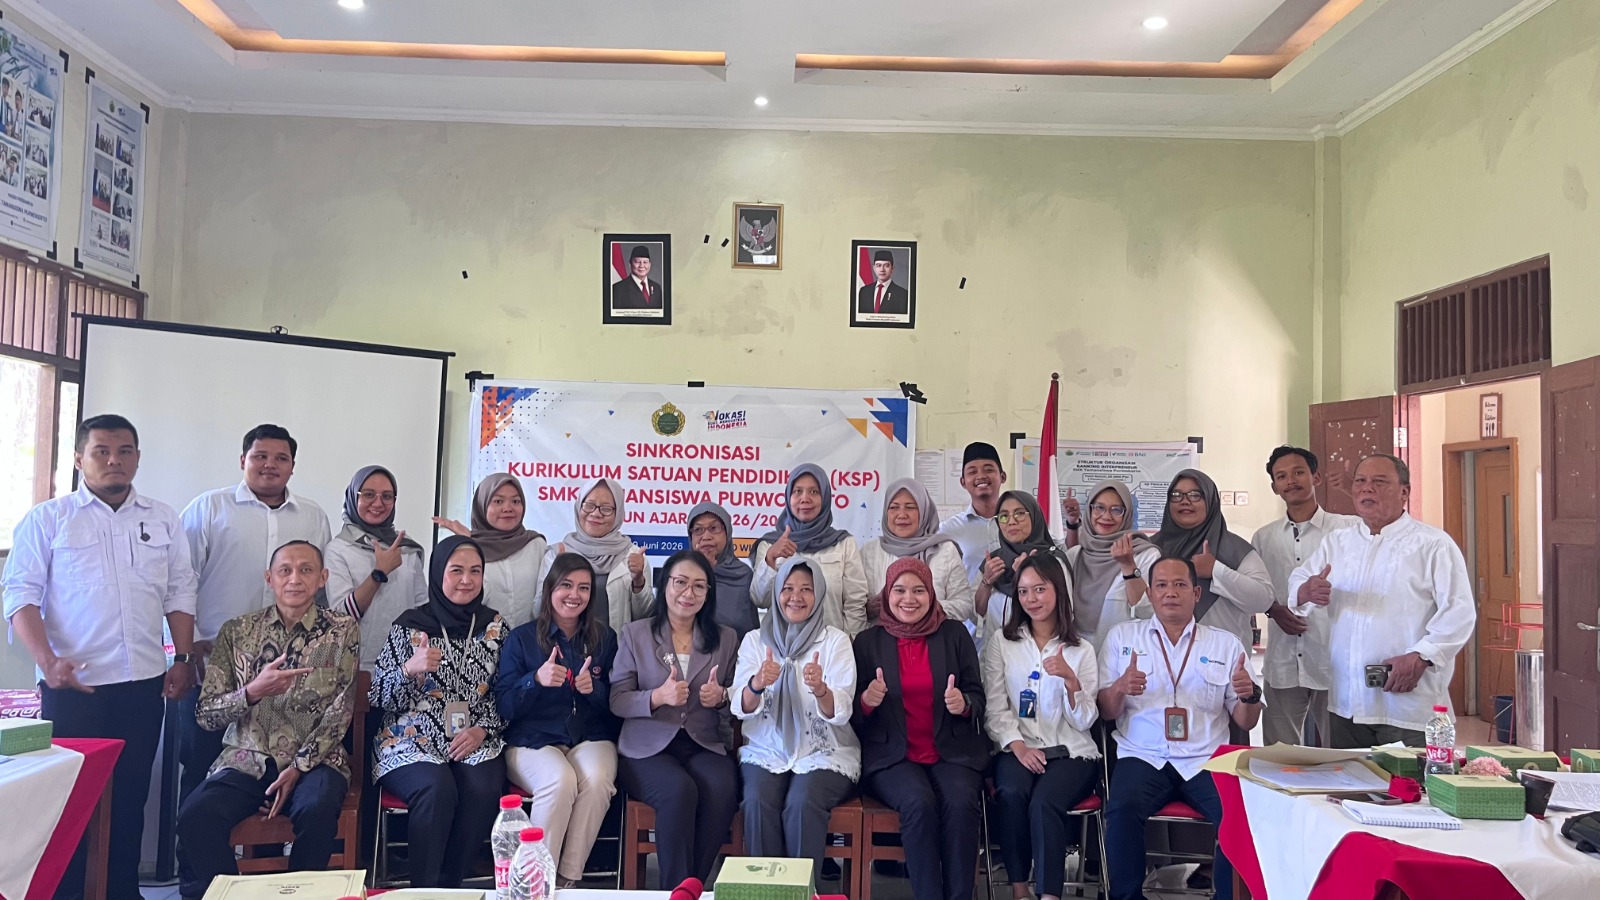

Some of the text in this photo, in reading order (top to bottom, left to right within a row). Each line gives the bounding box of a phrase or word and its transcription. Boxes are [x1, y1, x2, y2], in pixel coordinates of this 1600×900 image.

[626, 443, 760, 461] SINKRONISASI
[508, 462, 621, 480] KURIKULUM
[628, 466, 702, 483] SATUAN
[831, 469, 880, 492] (KSP)
[538, 487, 580, 501] SMK
[622, 488, 712, 506] ANSISWA
[649, 512, 687, 525] AJAR
[732, 513, 778, 530] 26/20
[660, 541, 684, 551] 2026
